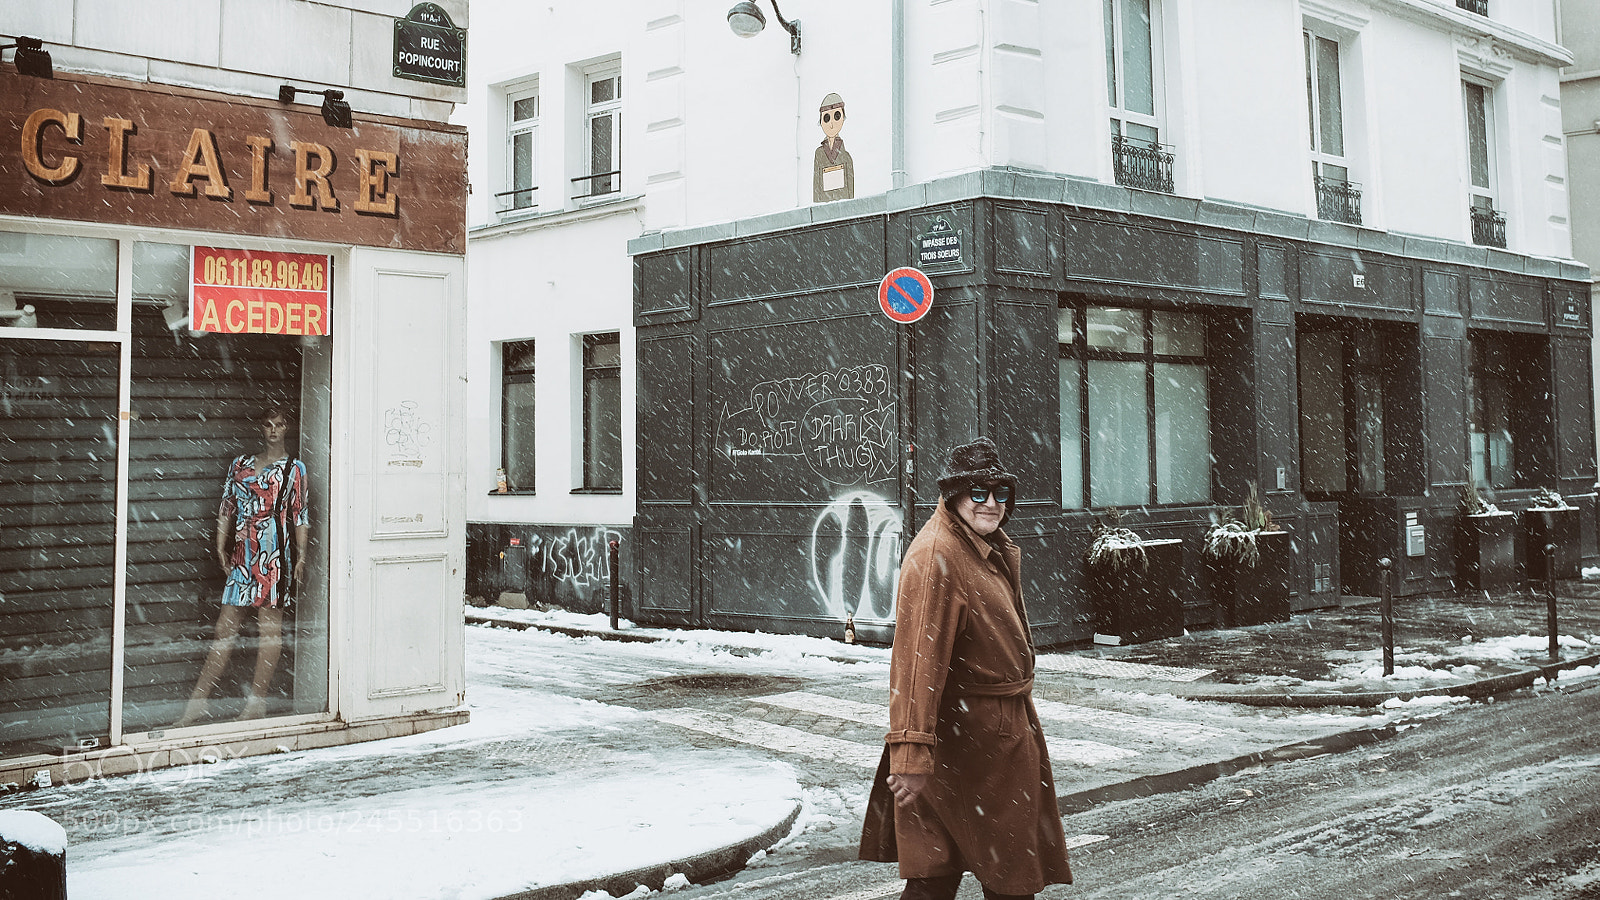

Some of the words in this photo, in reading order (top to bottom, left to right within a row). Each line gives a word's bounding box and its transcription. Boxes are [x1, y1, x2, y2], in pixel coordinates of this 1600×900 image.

[420, 36, 440, 51] RUE
[399, 51, 460, 72] POPINCOURT
[21, 108, 399, 216] CLAIRE
[922, 237, 945, 249] IMPASSE
[946, 236, 958, 246] DES
[920, 251, 937, 261] TROIS
[203, 255, 323, 291] 06.11.83.96.46
[200, 298, 222, 332] A
[225, 299, 323, 336] CEDER
[754, 374, 833, 428] POWER
[839, 366, 887, 396] 0383
[814, 445, 872, 468] THUG
